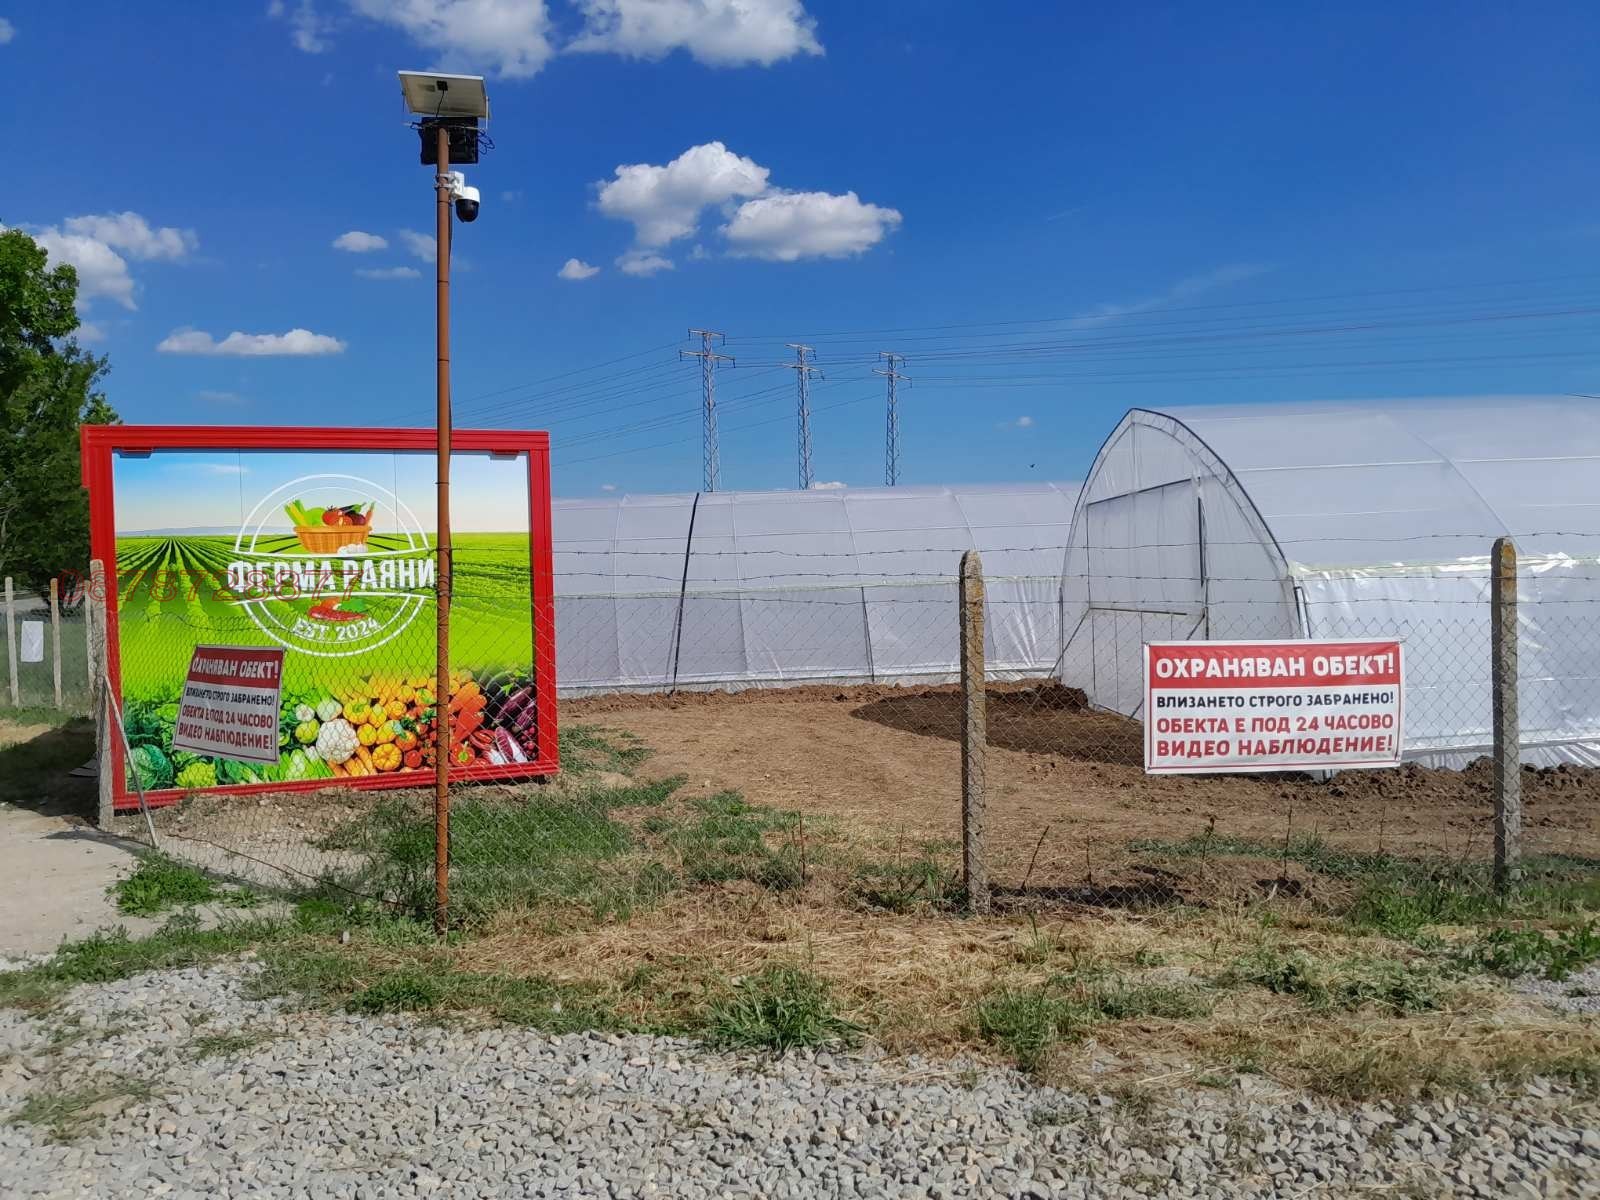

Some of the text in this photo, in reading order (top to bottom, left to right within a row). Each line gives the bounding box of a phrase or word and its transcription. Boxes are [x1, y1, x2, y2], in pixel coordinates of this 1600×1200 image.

[227, 559, 435, 593] ФЕРМА РАЯНИ
[336, 617, 381, 640] 2024
[239, 660, 279, 679] ОБЕКТ!
[1156, 652, 1395, 679] ОХРАНЯВАН ОБЕКТ!
[1156, 691, 1394, 709] ВЛИЗАНЕТО СТРОГО ЗАБРАНЕНО!
[225, 711, 236, 724] 24
[237, 713, 273, 729] ЧАСОВО
[1156, 713, 1394, 734] ОБЕКТА Е ПОД 24 ЧАСОВО
[204, 727, 273, 750] НАБЛЮДЕНИЕ!
[1156, 735, 1393, 758] ВИДЕО НАБЛЮДЕНИЕ!
